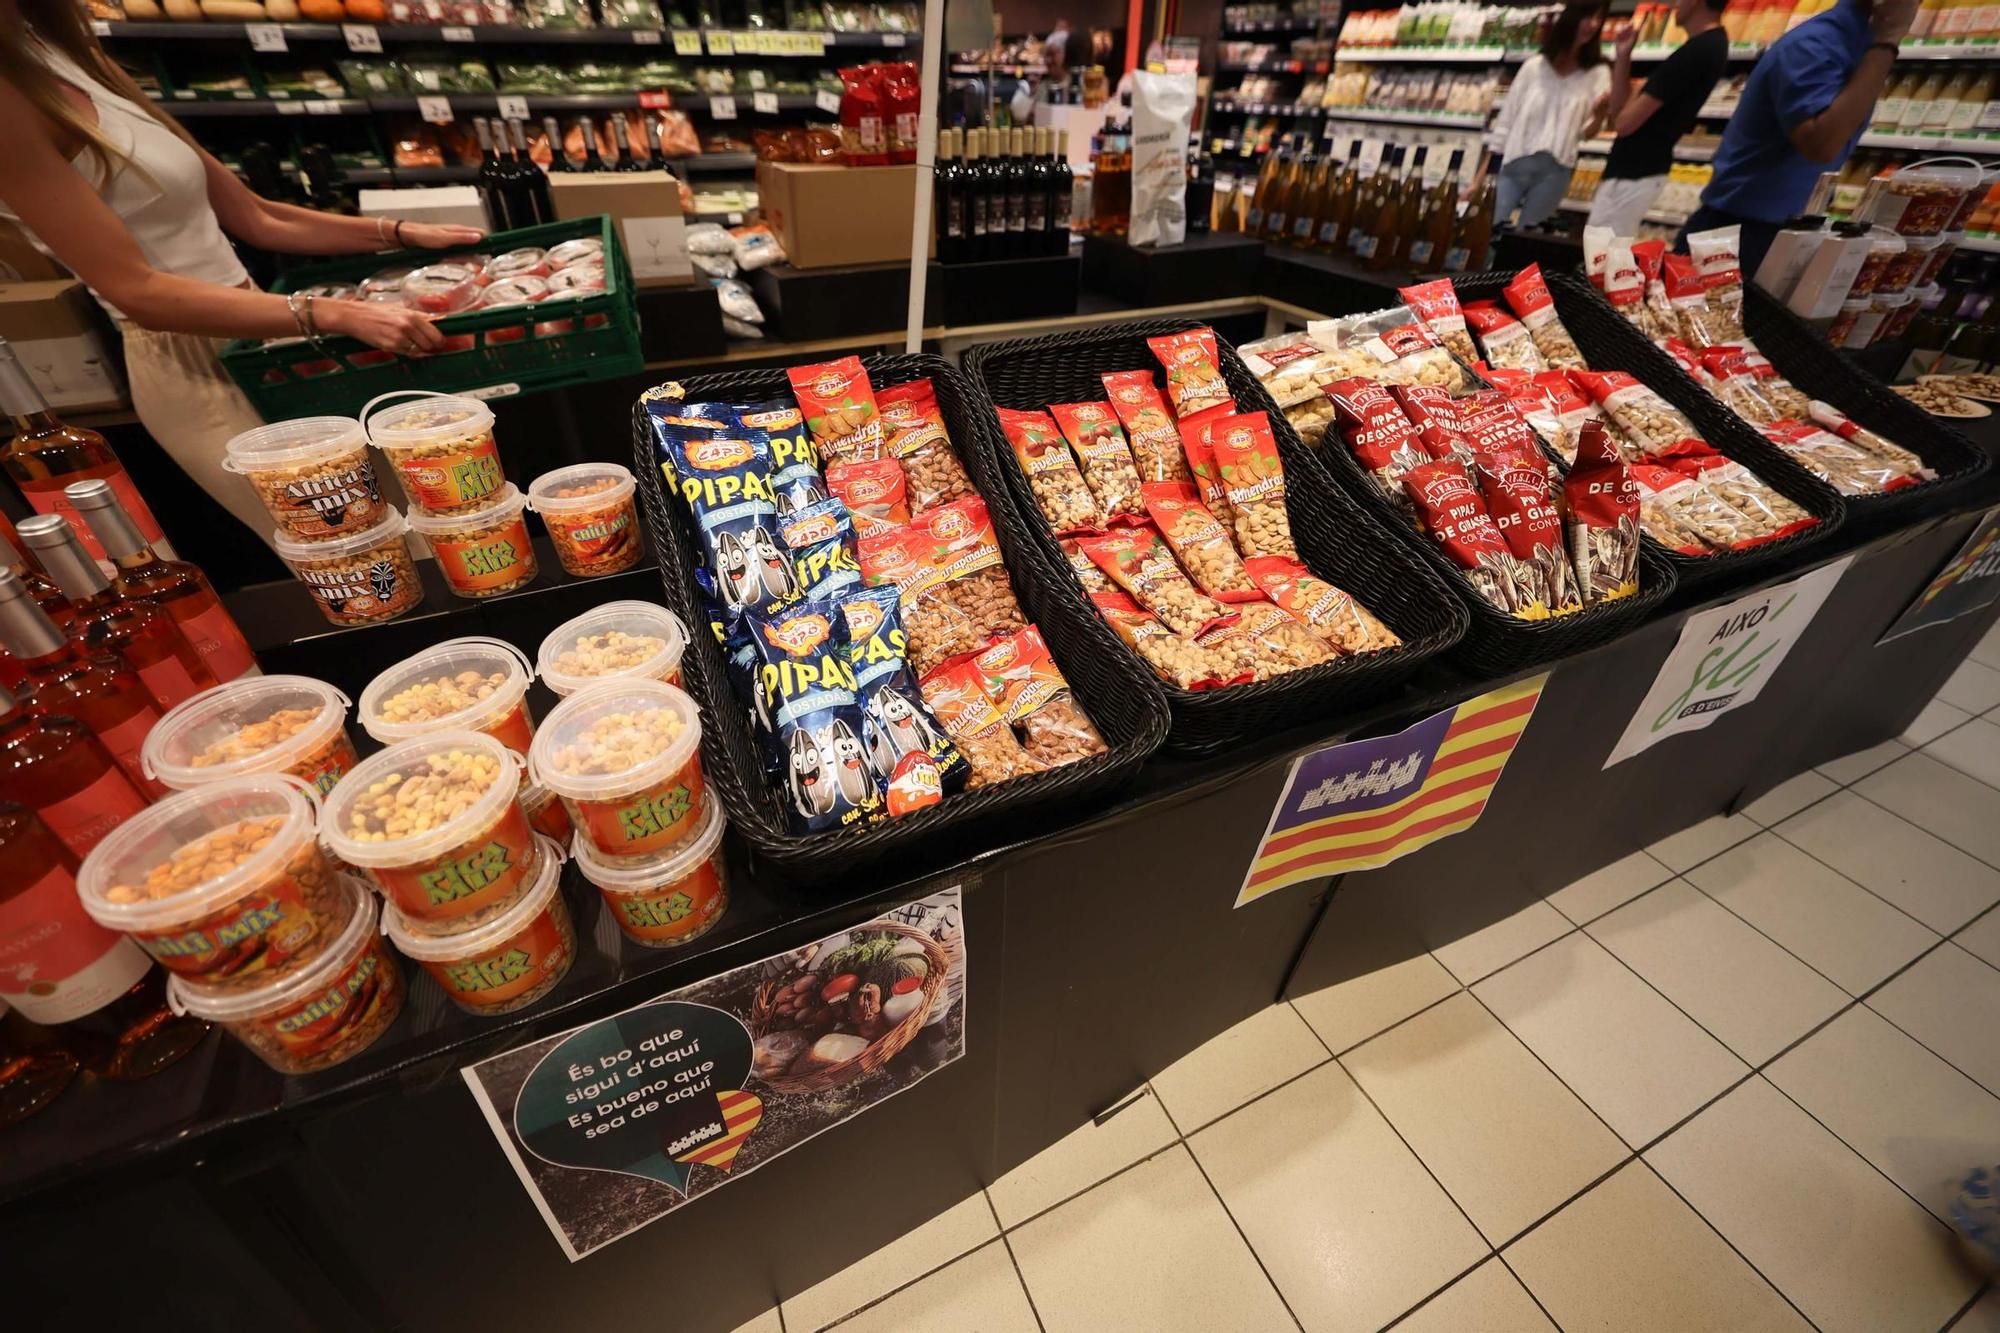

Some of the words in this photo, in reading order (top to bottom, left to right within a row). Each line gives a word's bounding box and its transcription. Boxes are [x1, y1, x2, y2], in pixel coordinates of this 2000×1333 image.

[751, 409, 797, 424] CAPO
[1413, 417, 1435, 436] DE
[1355, 430, 1375, 445] DE
[1483, 439, 1509, 454] CON
[696, 446, 746, 461] CAPO
[287, 469, 359, 499] Africa
[1588, 481, 1614, 494] DE
[311, 486, 368, 512] mix
[1449, 502, 1476, 520] PIPAS
[1497, 515, 1522, 530] DE
[1528, 520, 1552, 532] CON
[1435, 525, 1456, 542] DE
[317, 584, 371, 601] mix
[1708, 599, 1771, 645] AIXÒ
[762, 653, 859, 708] PIPAS
[841, 807, 862, 826] con
[216, 897, 287, 946] MIX
[567, 1063, 595, 1083] És
[599, 1048, 634, 1070] bo
[638, 1027, 684, 1054] que
[565, 1071, 621, 1105] sigui
[626, 1038, 701, 1079] d'aquí
[567, 1111, 593, 1129] Es
[595, 1078, 669, 1118] bueno
[673, 1059, 716, 1084] que
[584, 1116, 627, 1140] sea
[630, 1099, 660, 1120] de
[664, 1075, 713, 1106] aquí
